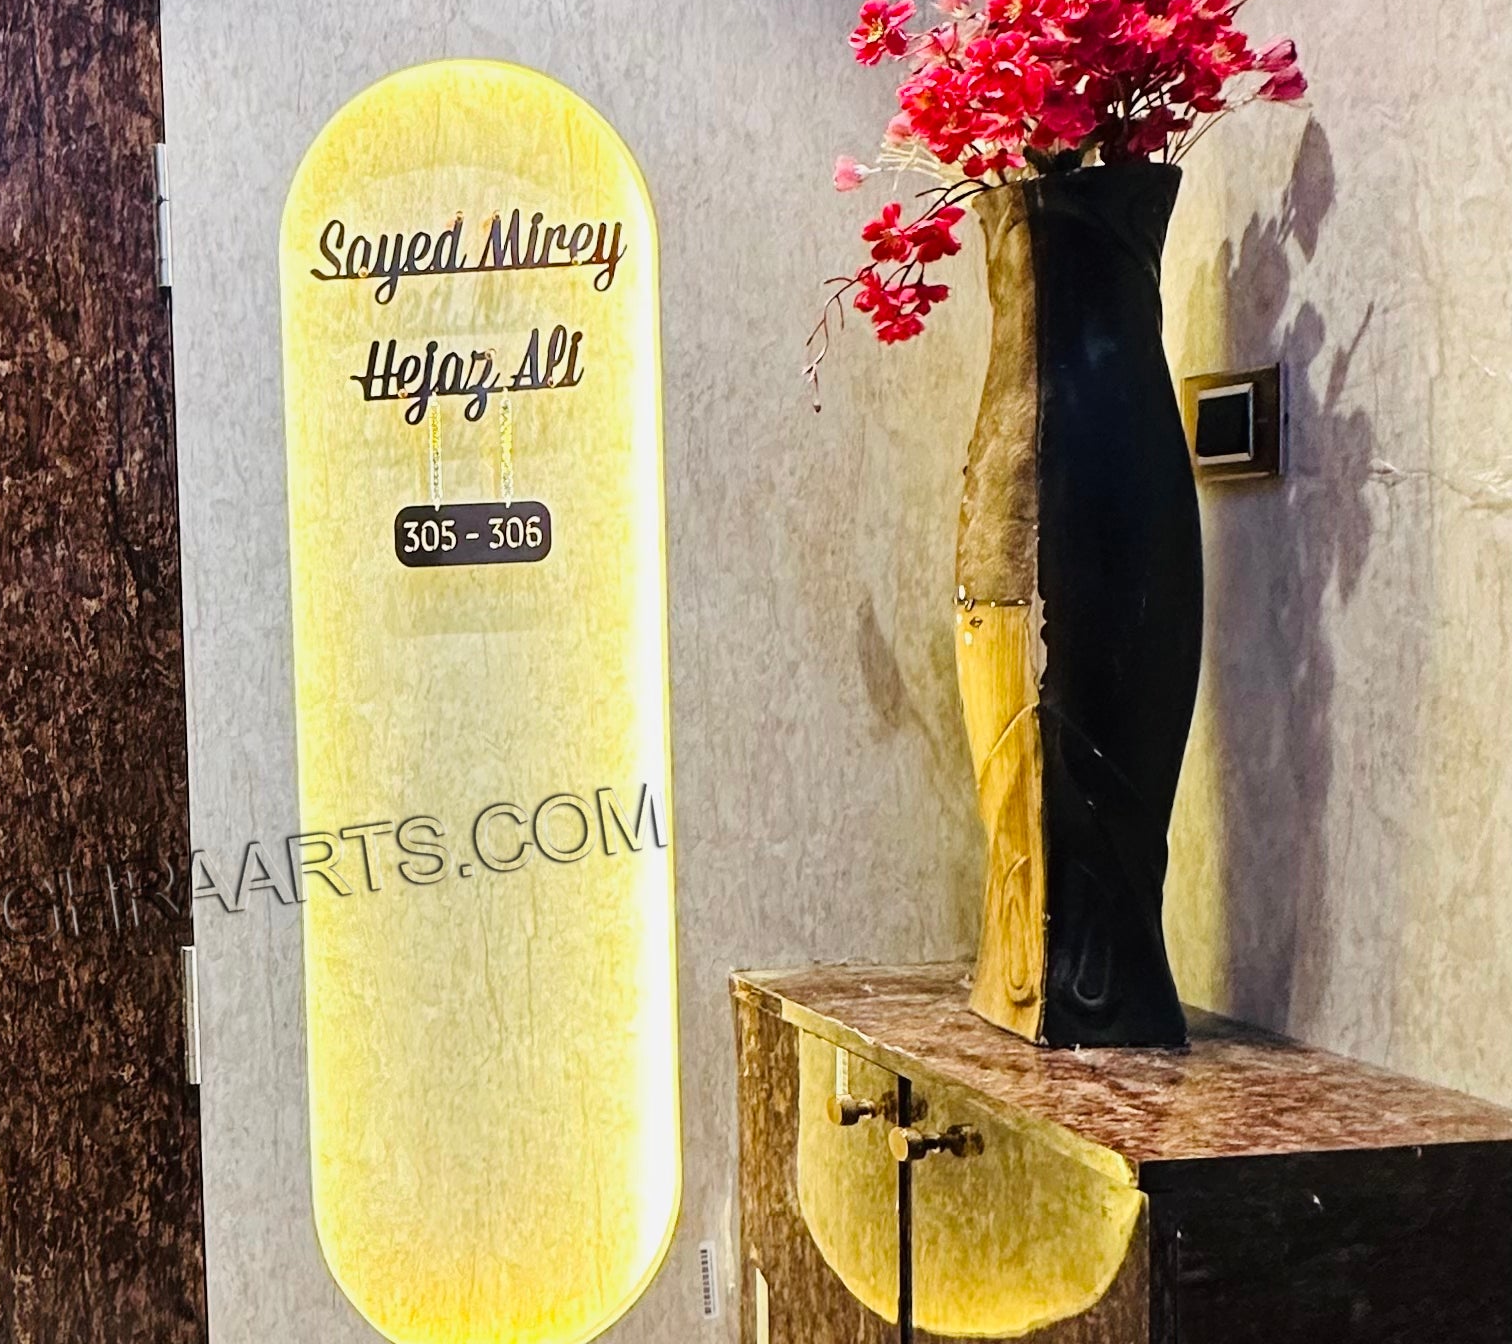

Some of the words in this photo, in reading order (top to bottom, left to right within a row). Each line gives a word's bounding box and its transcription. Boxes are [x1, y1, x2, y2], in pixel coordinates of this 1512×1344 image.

[310, 211, 468, 305] Sayed
[476, 208, 628, 292] Mirey
[350, 339, 500, 425] Hejaz
[510, 324, 585, 393] Ali
[402, 519, 458, 553] 305
[488, 515, 543, 549] 306
